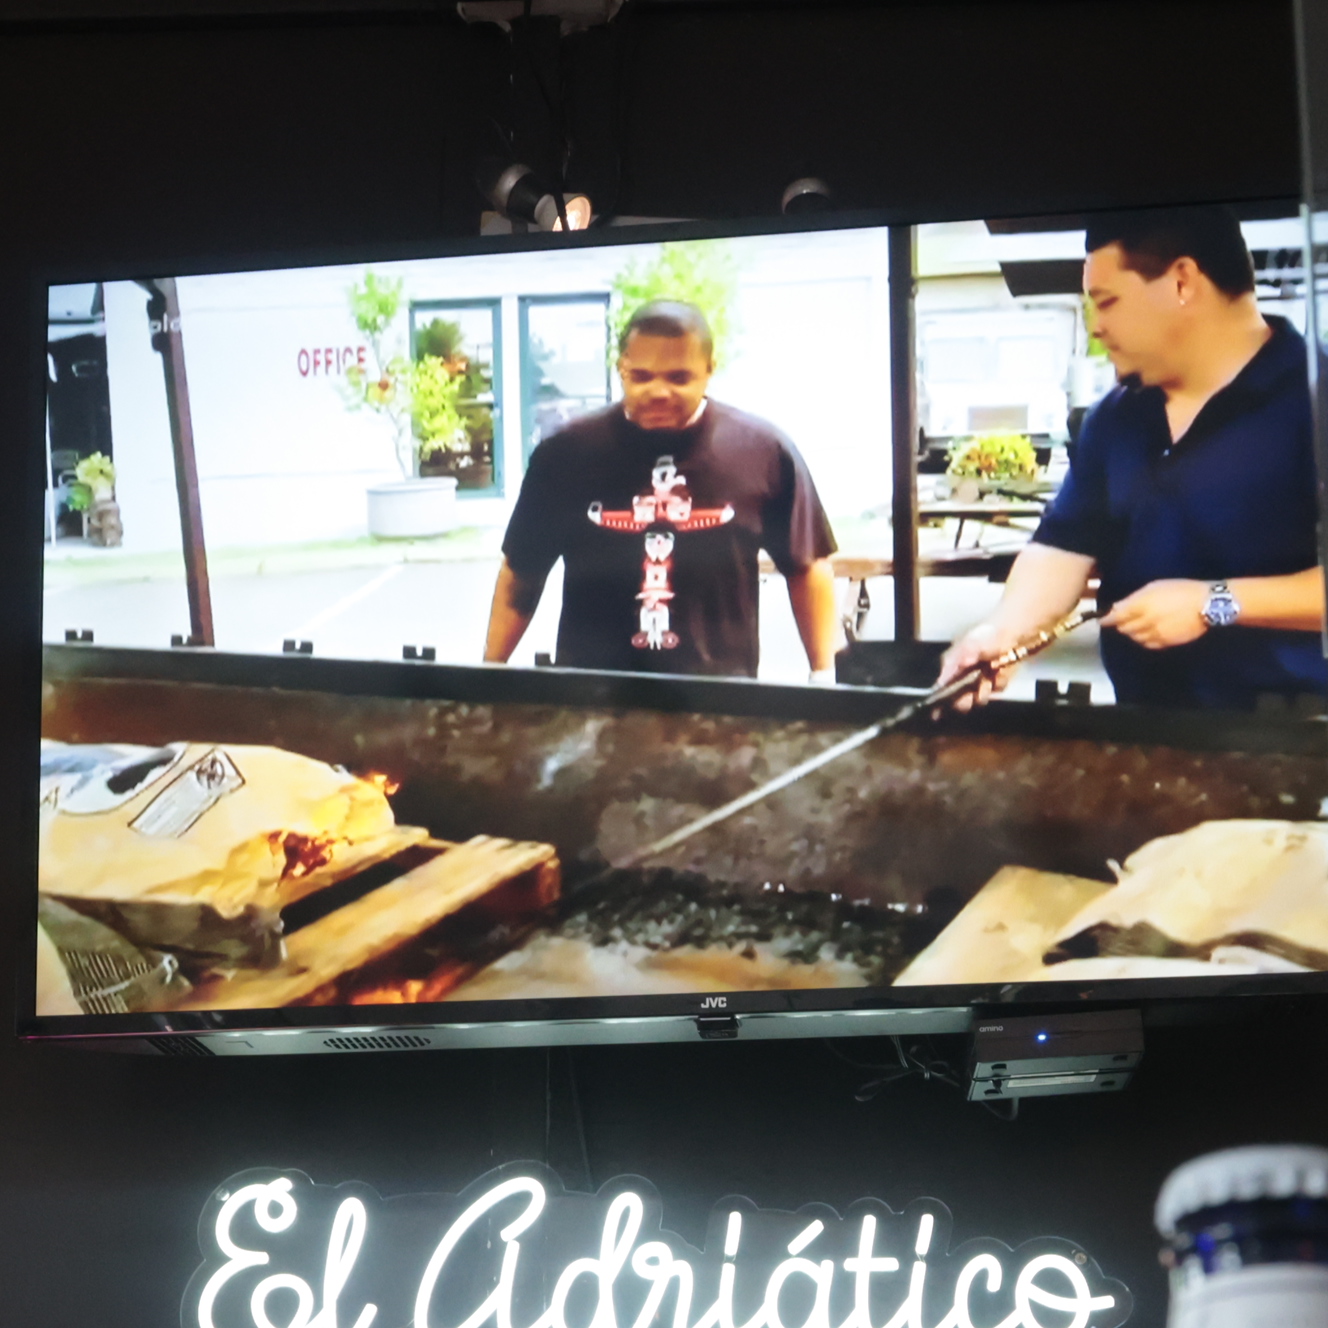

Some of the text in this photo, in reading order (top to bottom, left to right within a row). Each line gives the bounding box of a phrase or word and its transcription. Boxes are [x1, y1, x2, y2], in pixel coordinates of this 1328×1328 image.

[297, 345, 367, 378] OFFICE
[701, 997, 727, 1008] JVC
[979, 1024, 1004, 1032] amino
